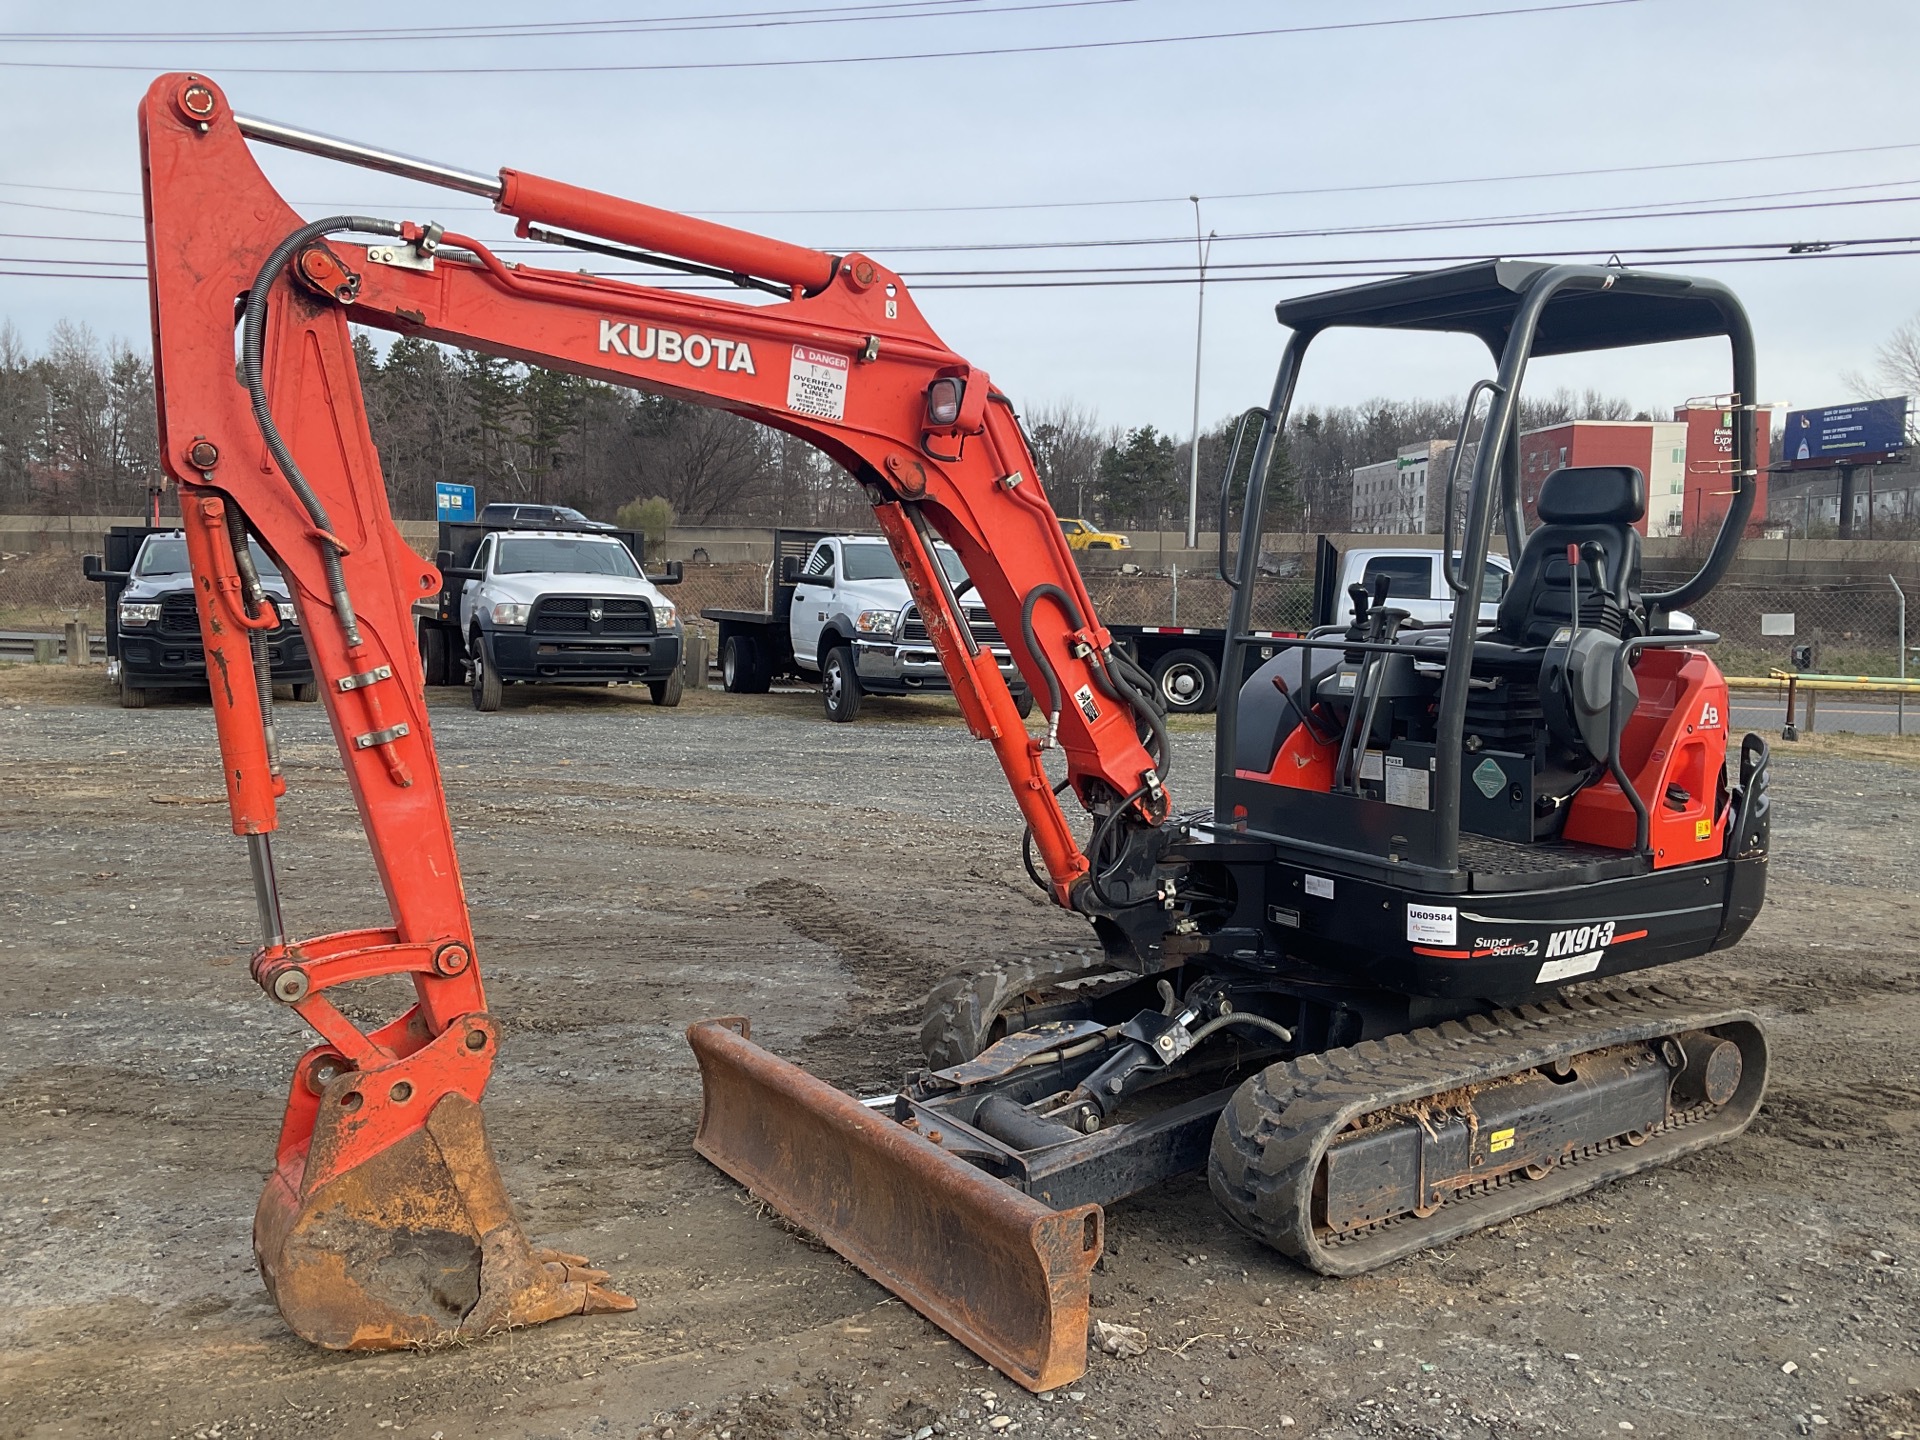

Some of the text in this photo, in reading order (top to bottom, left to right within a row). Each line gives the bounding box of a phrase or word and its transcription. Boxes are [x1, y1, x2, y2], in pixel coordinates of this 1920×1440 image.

[599, 319, 756, 375] KUBOTA
[809, 352, 846, 368] DANGER
[793, 374, 843, 391] OVERHEAD
[801, 382, 833, 395] POWER
[804, 388, 830, 399] LINES
[1386, 757, 1402, 765] FUSE
[1410, 910, 1453, 921] U609584
[1474, 937, 1512, 949] Super
[1545, 921, 1616, 958] KX91-3
[1491, 939, 1539, 957] Series 2
